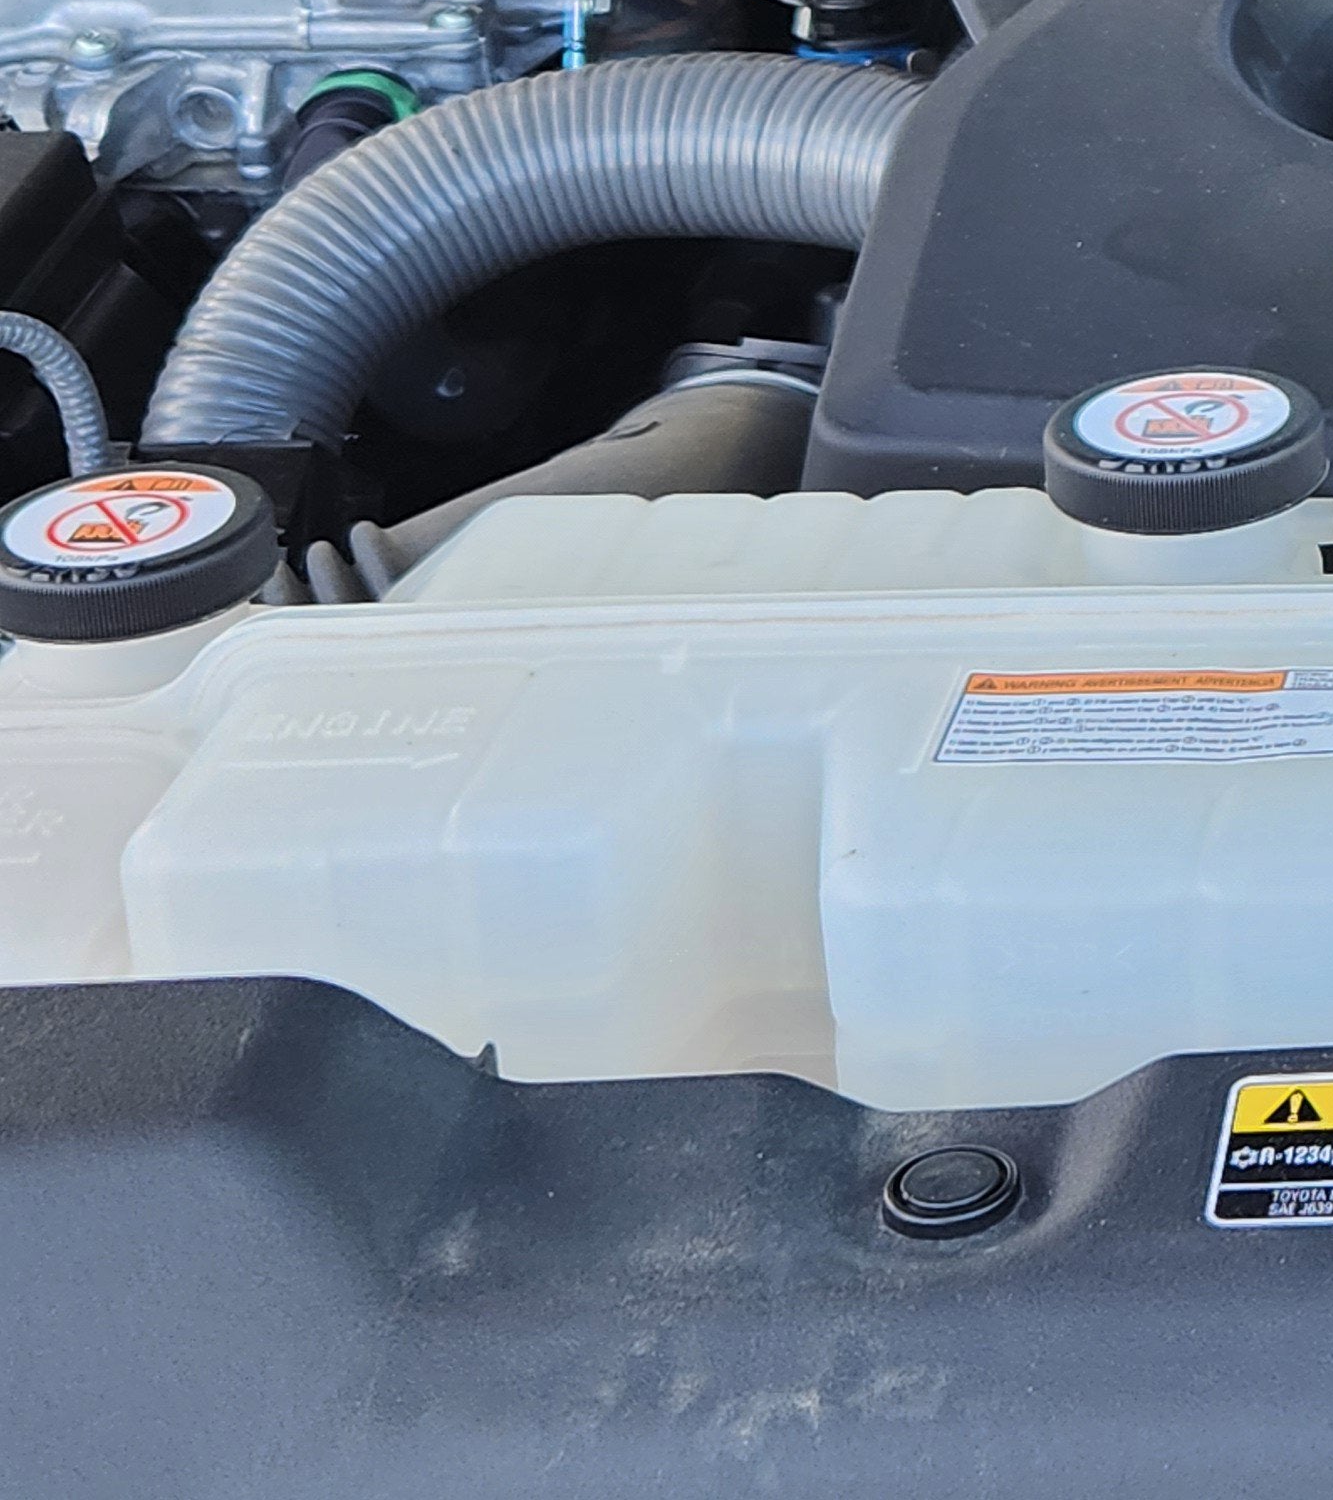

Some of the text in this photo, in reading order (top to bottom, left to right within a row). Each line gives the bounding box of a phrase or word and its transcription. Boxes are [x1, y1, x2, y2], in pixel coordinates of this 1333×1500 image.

[1003, 678, 1077, 690] WARNING
[1270, 1189, 1328, 1202] TOYOTA
[1268, 1203, 1295, 1216] SAE
